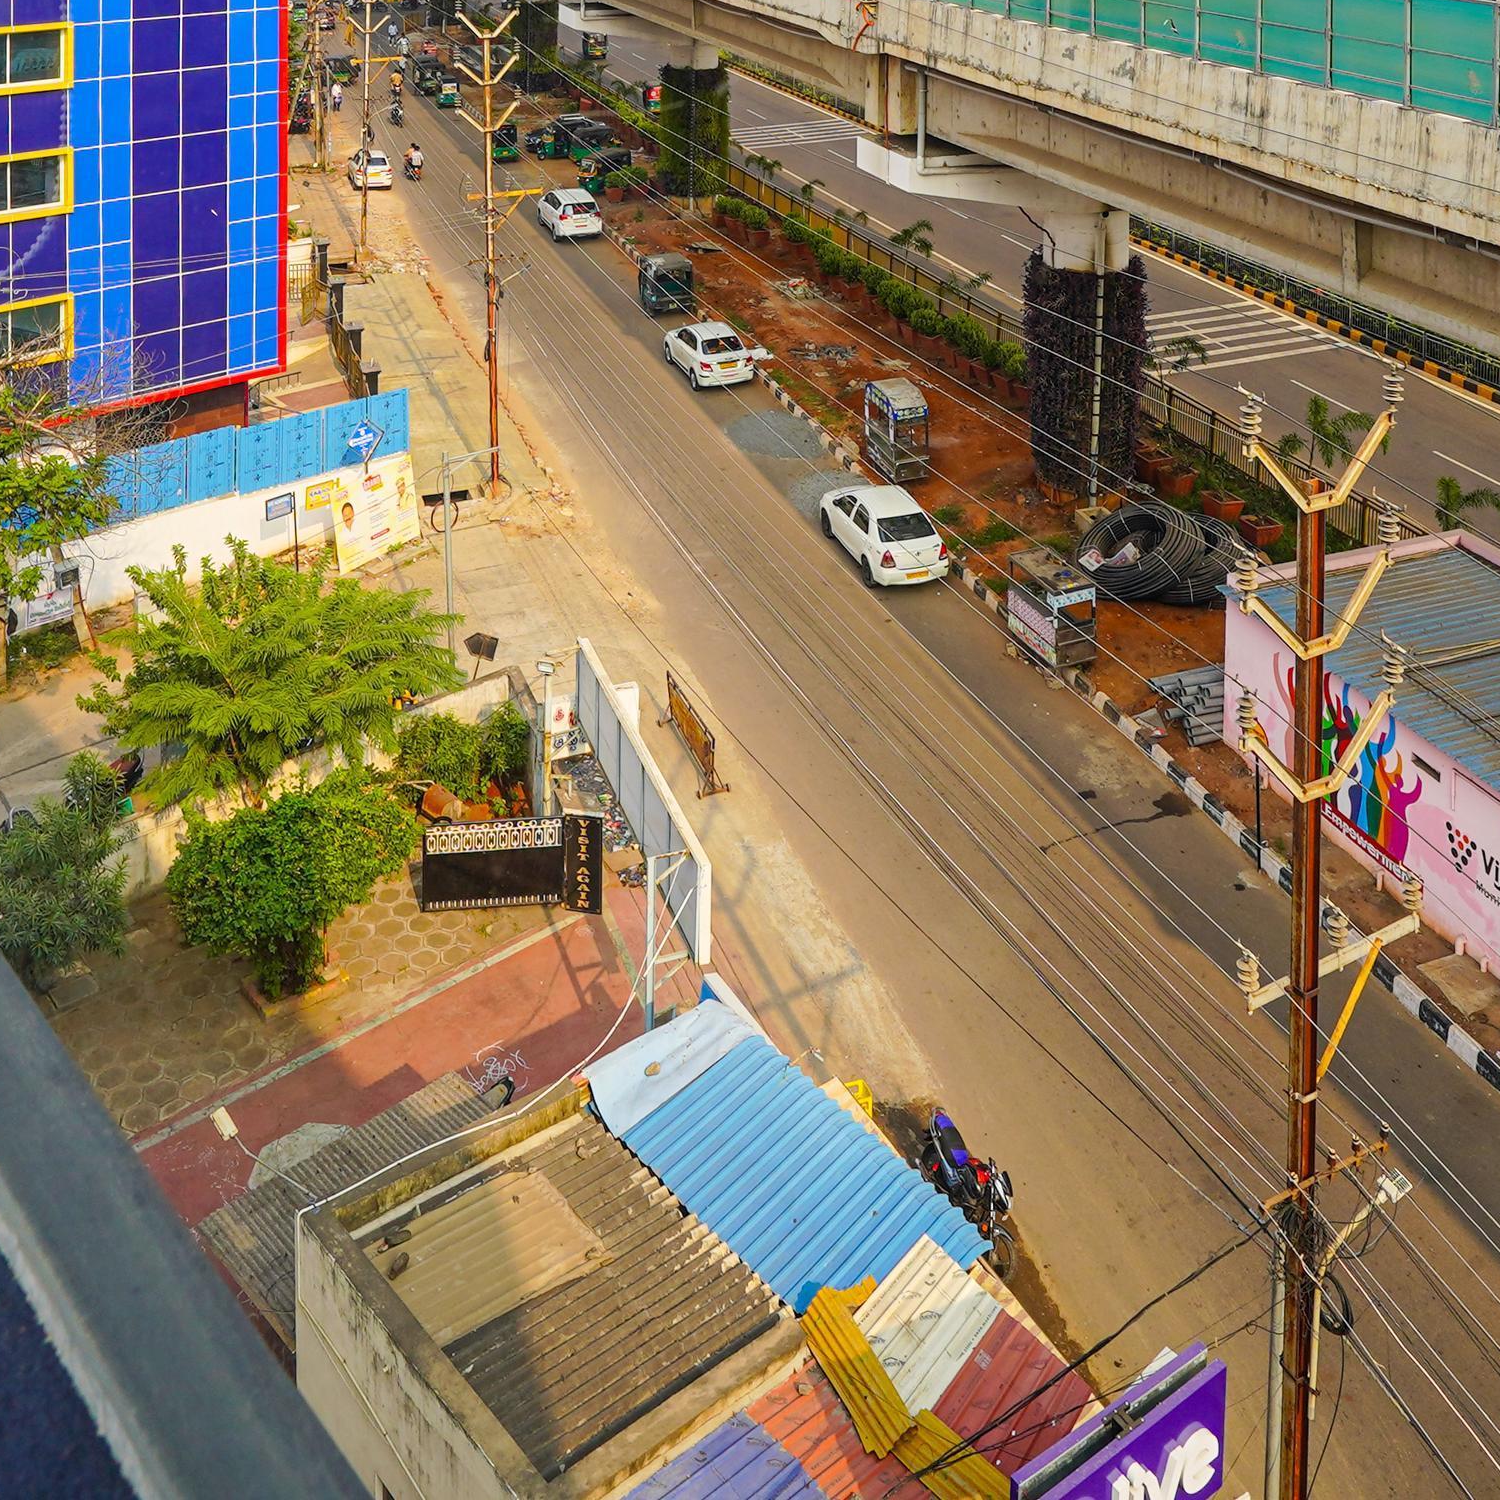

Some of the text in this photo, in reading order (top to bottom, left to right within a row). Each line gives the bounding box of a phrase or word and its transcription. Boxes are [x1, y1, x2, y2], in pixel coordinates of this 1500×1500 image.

[576, 819, 590, 861] VISIT
[1324, 802, 1414, 884] Empowermen
[576, 866, 591, 909] AGAIN
